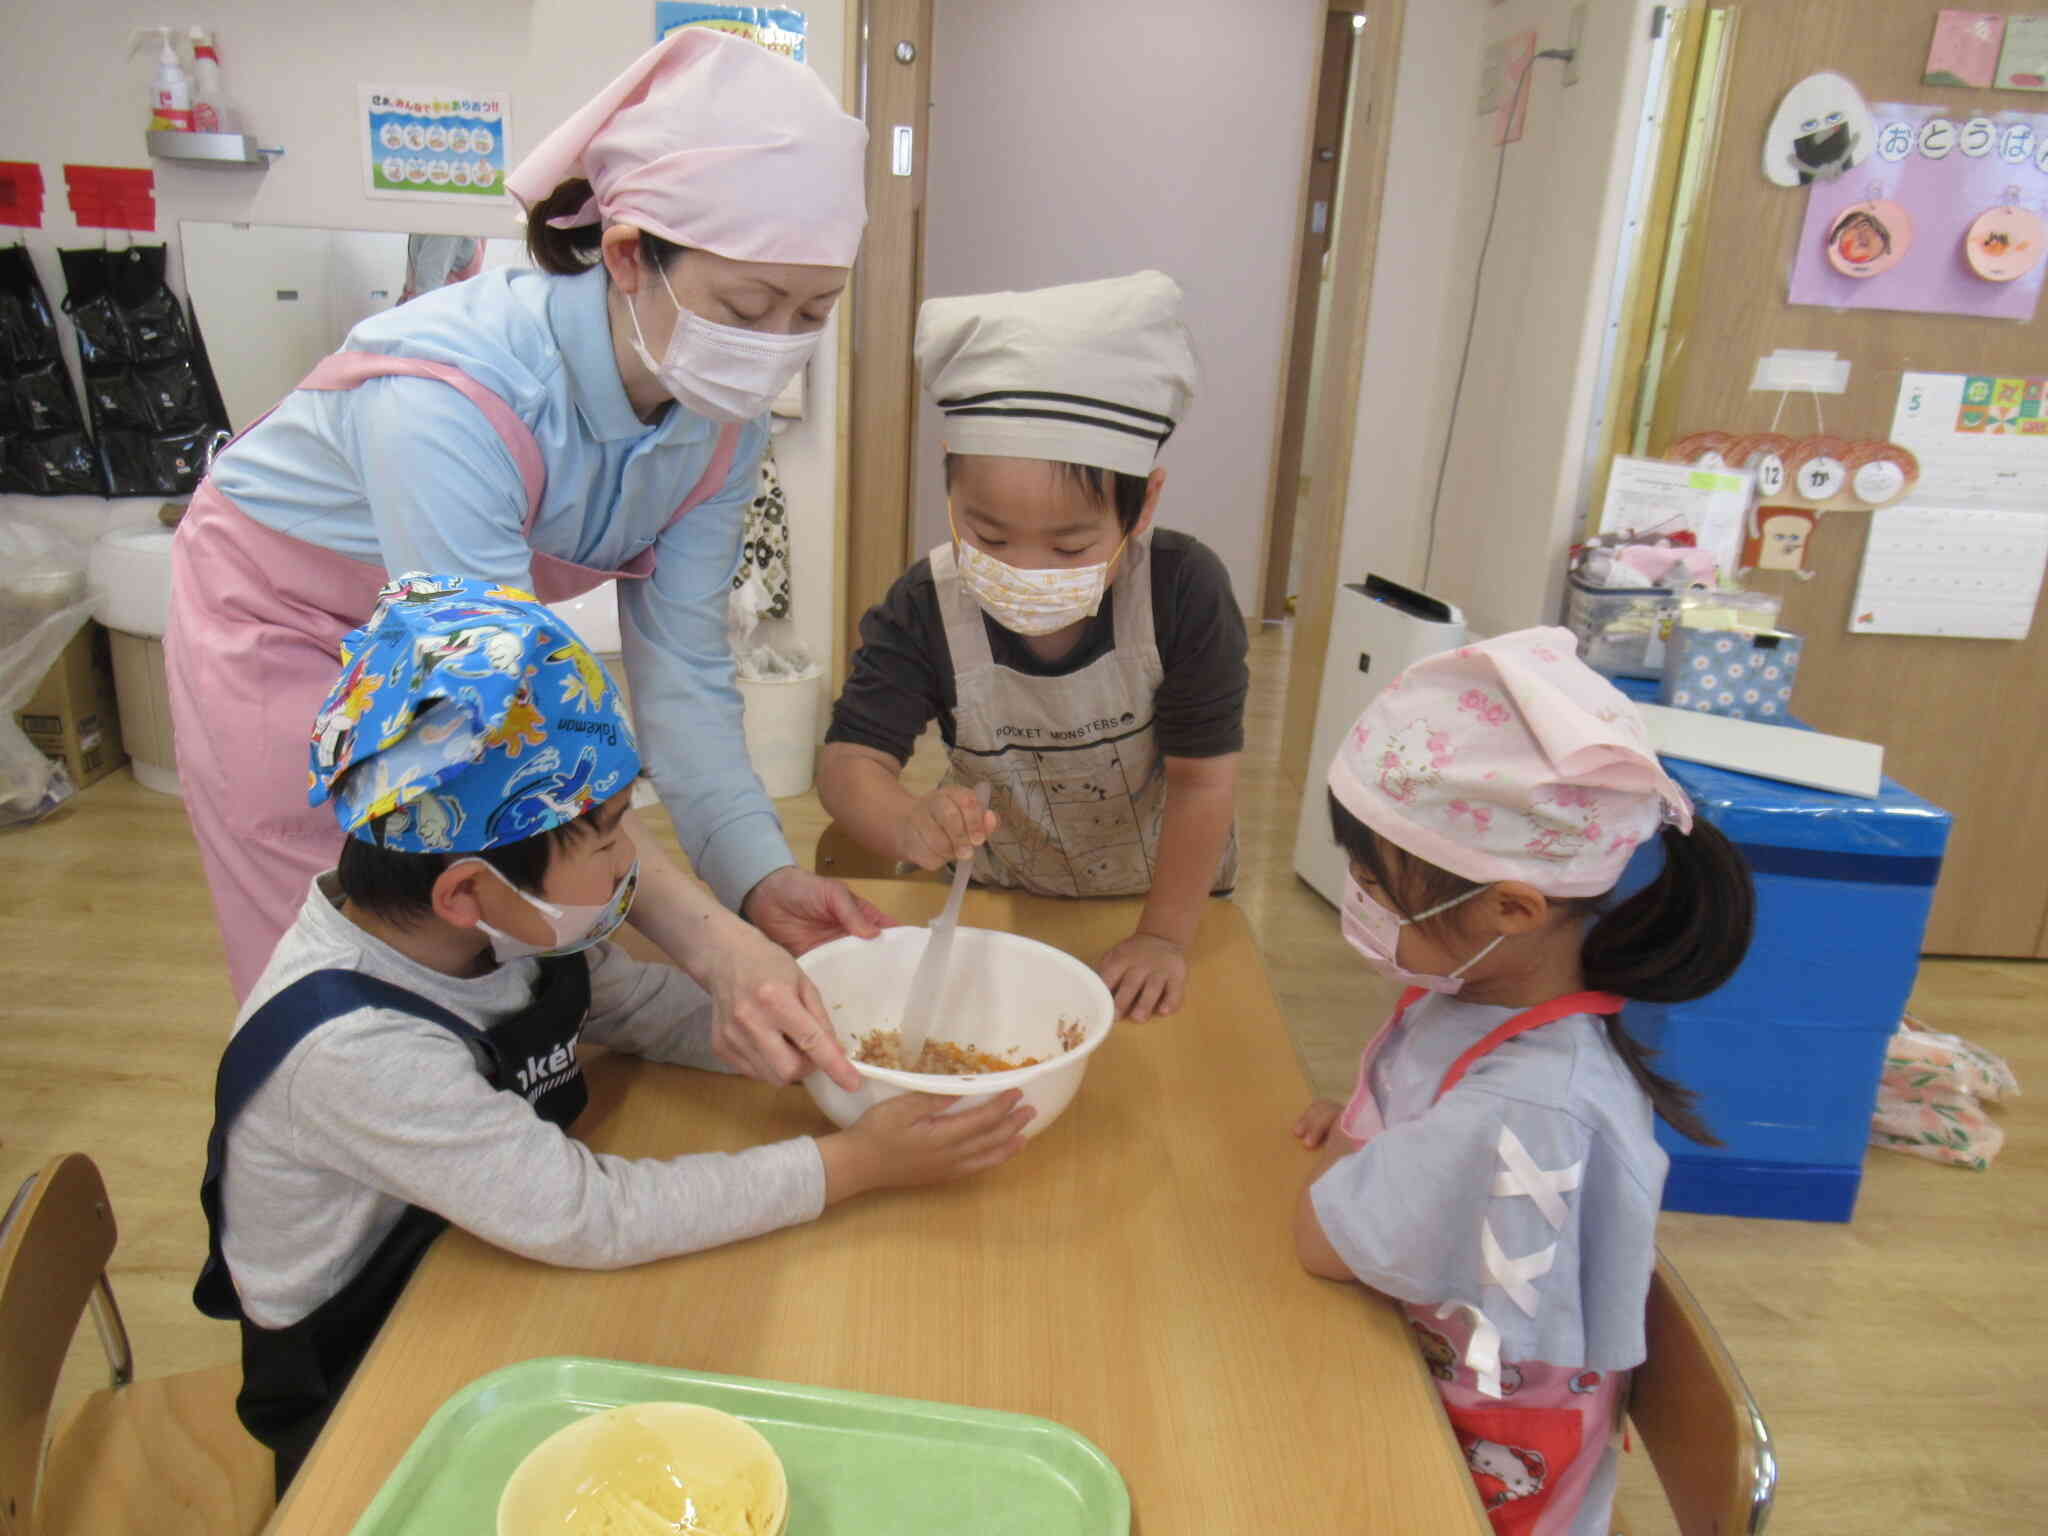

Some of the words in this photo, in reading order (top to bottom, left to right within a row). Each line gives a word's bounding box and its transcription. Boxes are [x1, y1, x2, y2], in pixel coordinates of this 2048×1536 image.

[1908, 393, 1922, 411] 5
[1764, 466, 1780, 485] 12
[557, 719, 617, 747] Pokémon
[996, 725, 1042, 738] POCKET
[1049, 717, 1119, 741] MONSTERS
